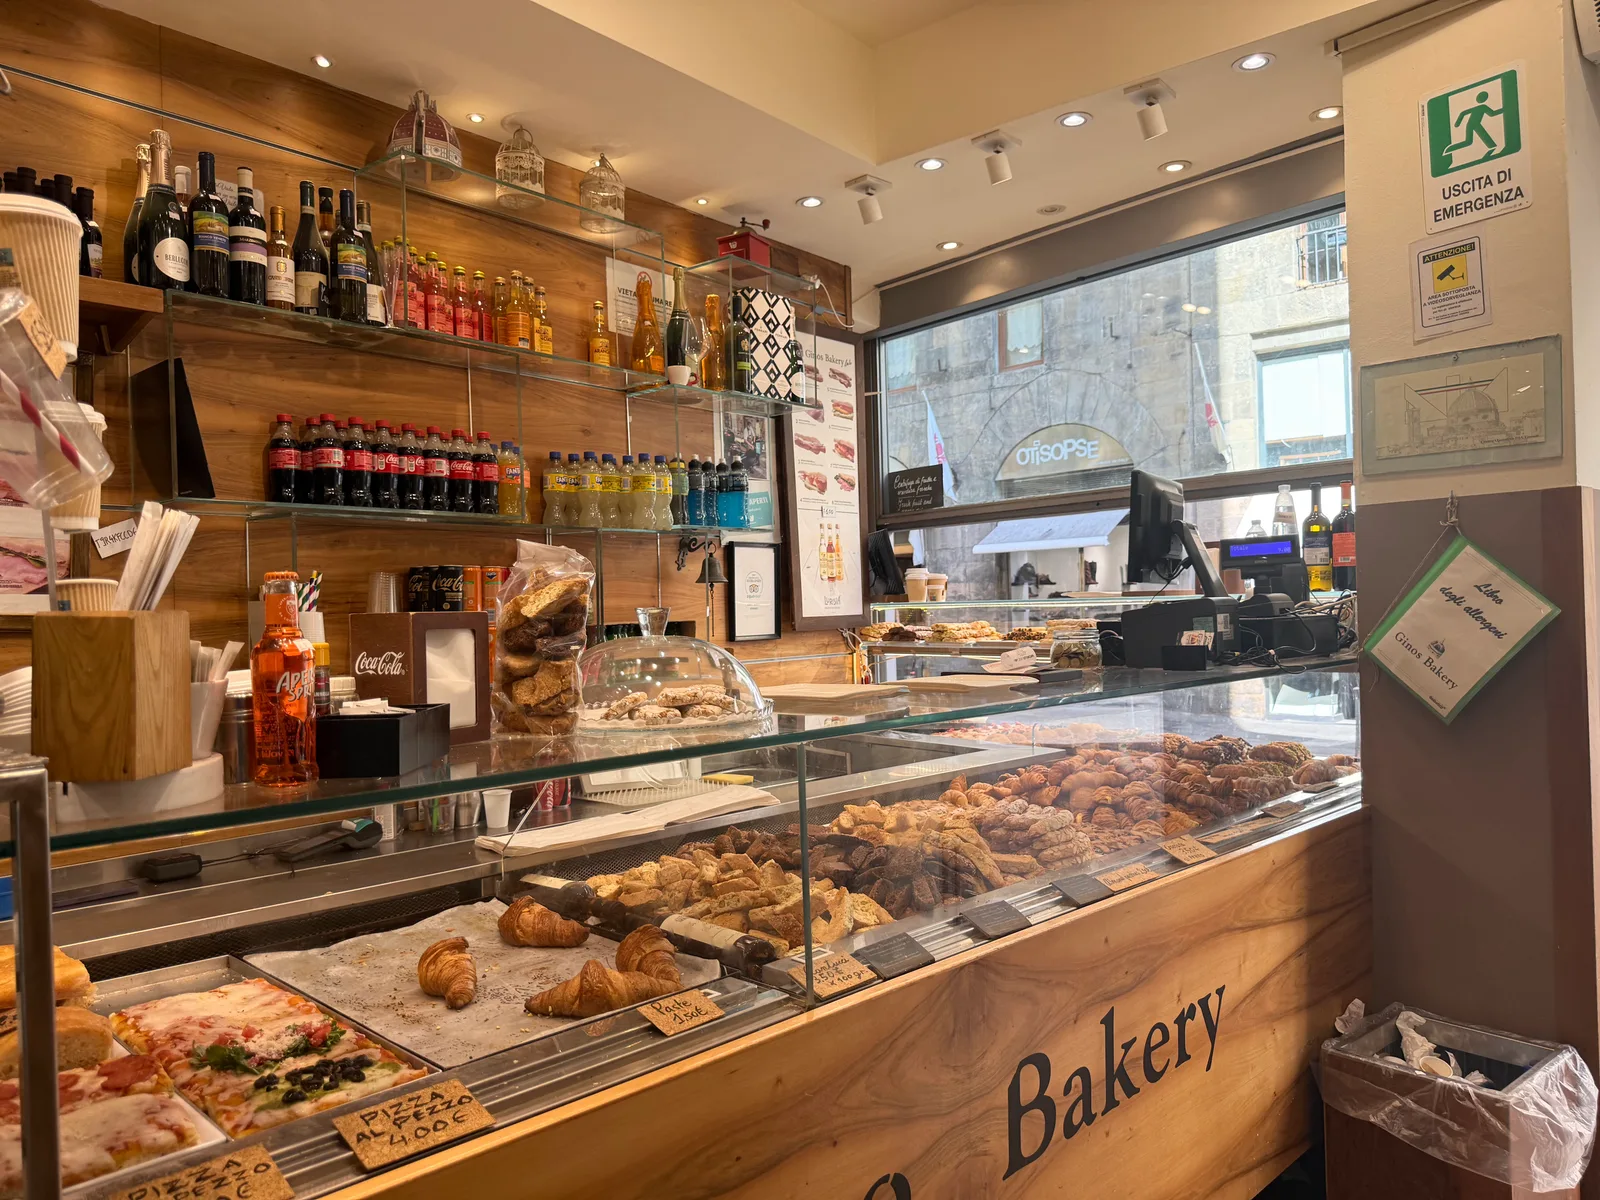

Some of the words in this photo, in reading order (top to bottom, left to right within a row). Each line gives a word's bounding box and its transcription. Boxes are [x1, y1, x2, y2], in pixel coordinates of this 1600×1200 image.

[1442, 174, 1493, 200] USCITA
[1497, 168, 1512, 184] DI
[1433, 185, 1525, 223] EMERGENZA
[1424, 243, 1475, 263] ATTENZIONE!
[617, 286, 638, 298] VIETA
[1427, 289, 1482, 306] VIDEOSORVEGLIANZA
[1442, 285, 1476, 297] SOTTOPOSTA
[825, 353, 845, 368] Bakery
[1473, 583, 1504, 605] Libro
[1439, 586, 1466, 606] degli
[1463, 606, 1508, 640] allergeni
[1394, 631, 1423, 660] Ginos
[1423, 655, 1459, 690] Bakery
[650, 999, 693, 1016] Paste
[1003, 984, 1226, 1182] Bakery
[356, 1129, 386, 1144] AL
[392, 1095, 474, 1129] PEZZO
[360, 1091, 445, 1127] PIZZA
[128, 1159, 242, 1200] PIZZA
